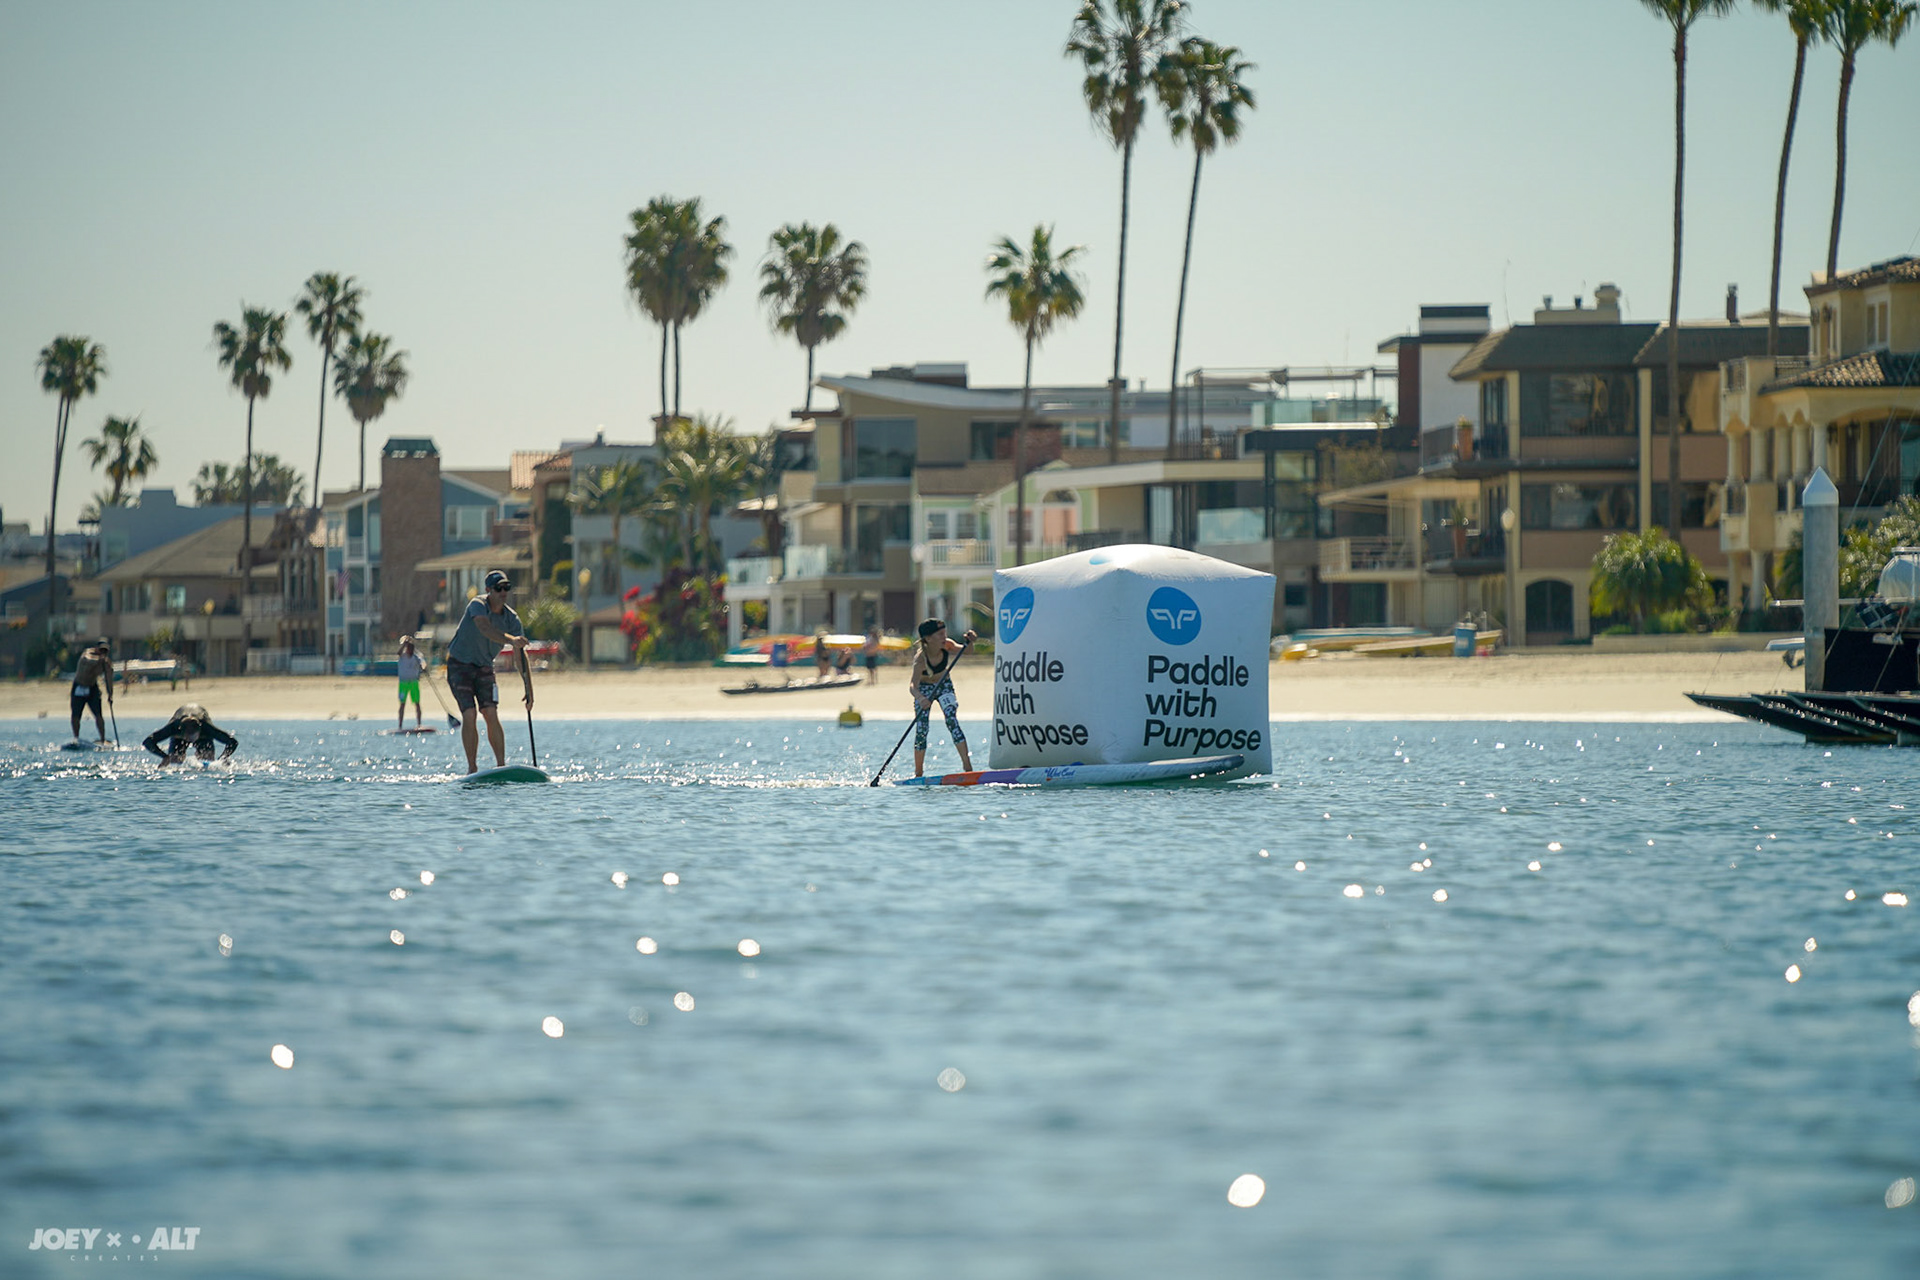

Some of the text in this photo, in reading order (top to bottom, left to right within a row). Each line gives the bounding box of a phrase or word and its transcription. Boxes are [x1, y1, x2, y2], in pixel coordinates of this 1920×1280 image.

[996, 651, 1064, 682] Paddle
[1147, 655, 1249, 687] Paddle
[995, 684, 1035, 715] with
[1145, 687, 1217, 718] with
[995, 718, 1088, 753] Purpose
[1143, 719, 1261, 755] Purpose
